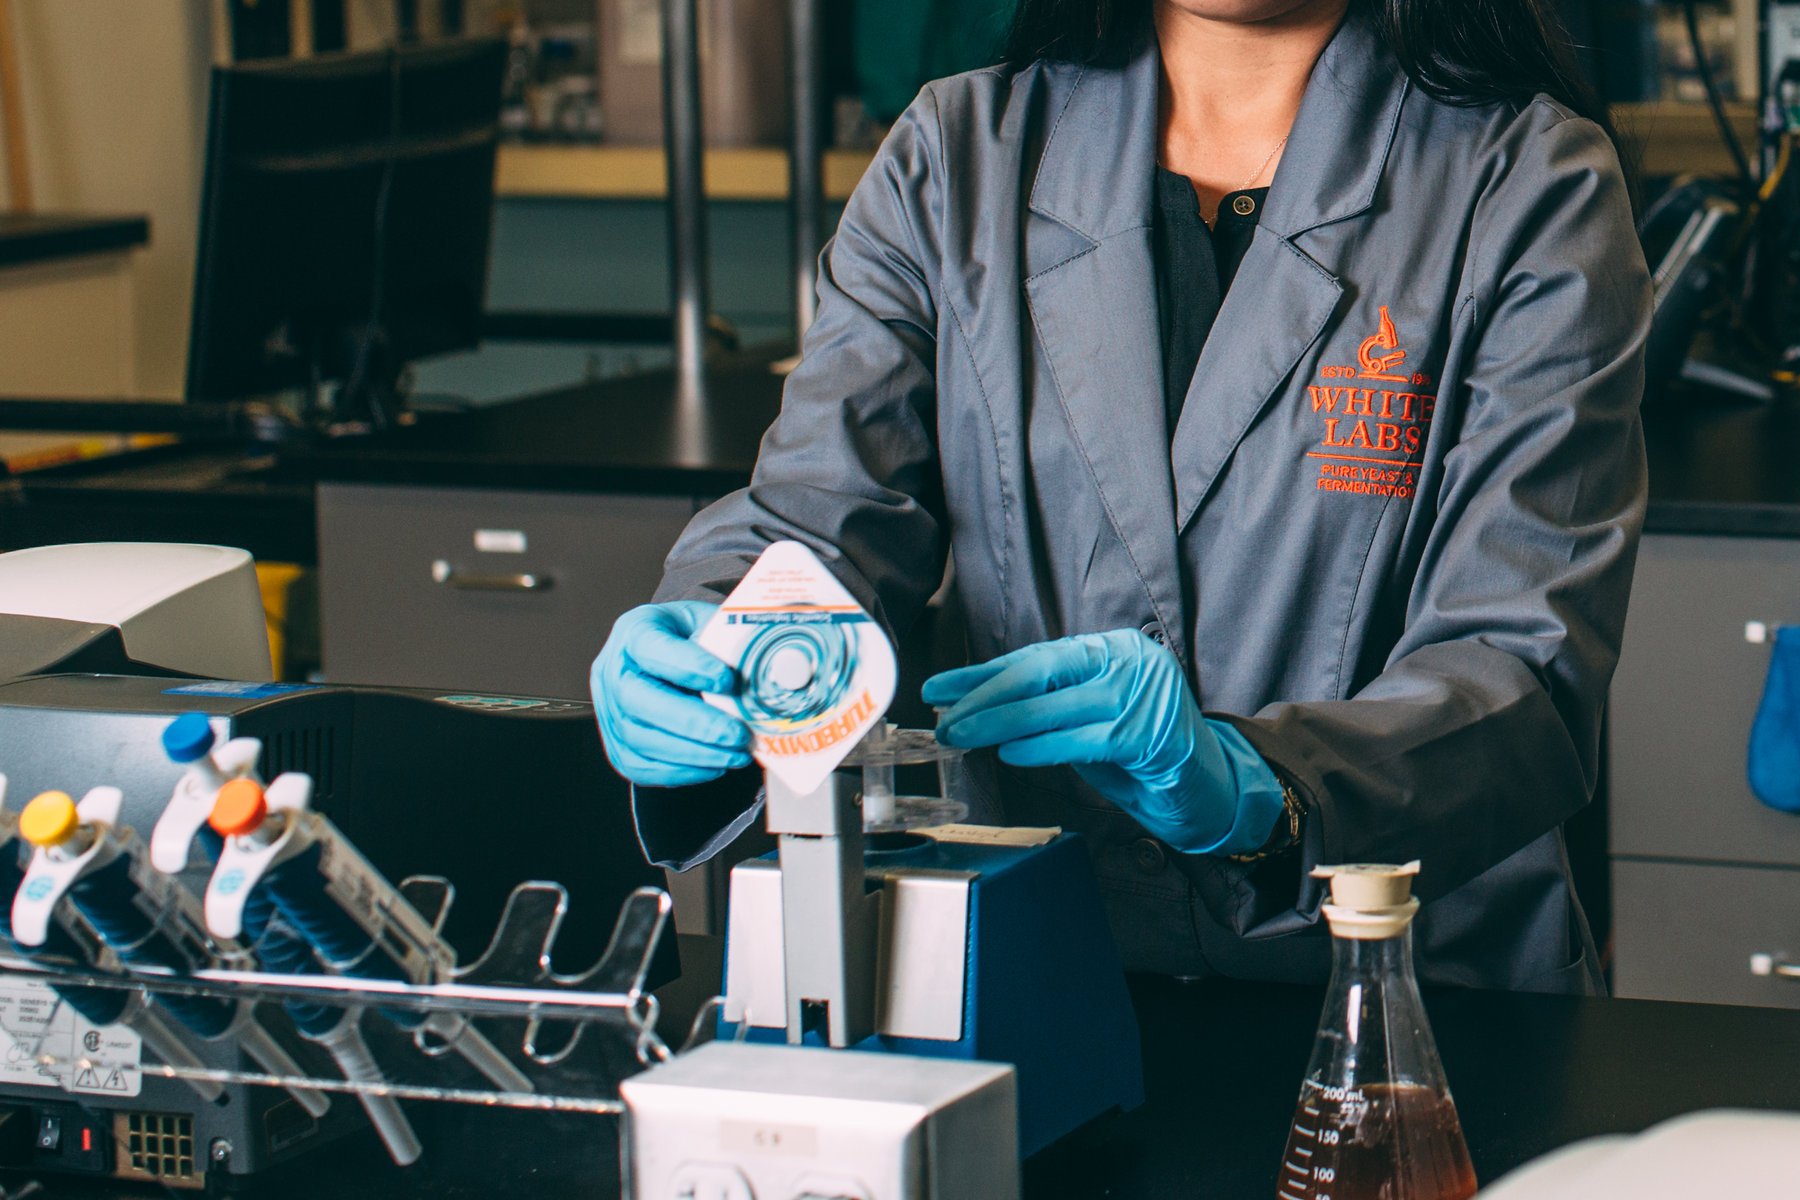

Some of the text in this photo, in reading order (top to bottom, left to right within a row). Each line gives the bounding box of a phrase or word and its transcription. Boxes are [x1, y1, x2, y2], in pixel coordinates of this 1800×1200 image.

[1321, 367, 1355, 378] ESTD
[1308, 387, 1436, 421] WHITE
[1322, 419, 1421, 453] LABS
[1321, 464, 1358, 478] PURE
[1359, 467, 1402, 483] YEAST
[1317, 478, 1416, 498] FERMENTATION
[765, 689, 876, 755] TURBOMIX
[1323, 1085, 1345, 1100] 200
[1318, 1128, 1339, 1145] 150
[1313, 1166, 1335, 1183] 100
